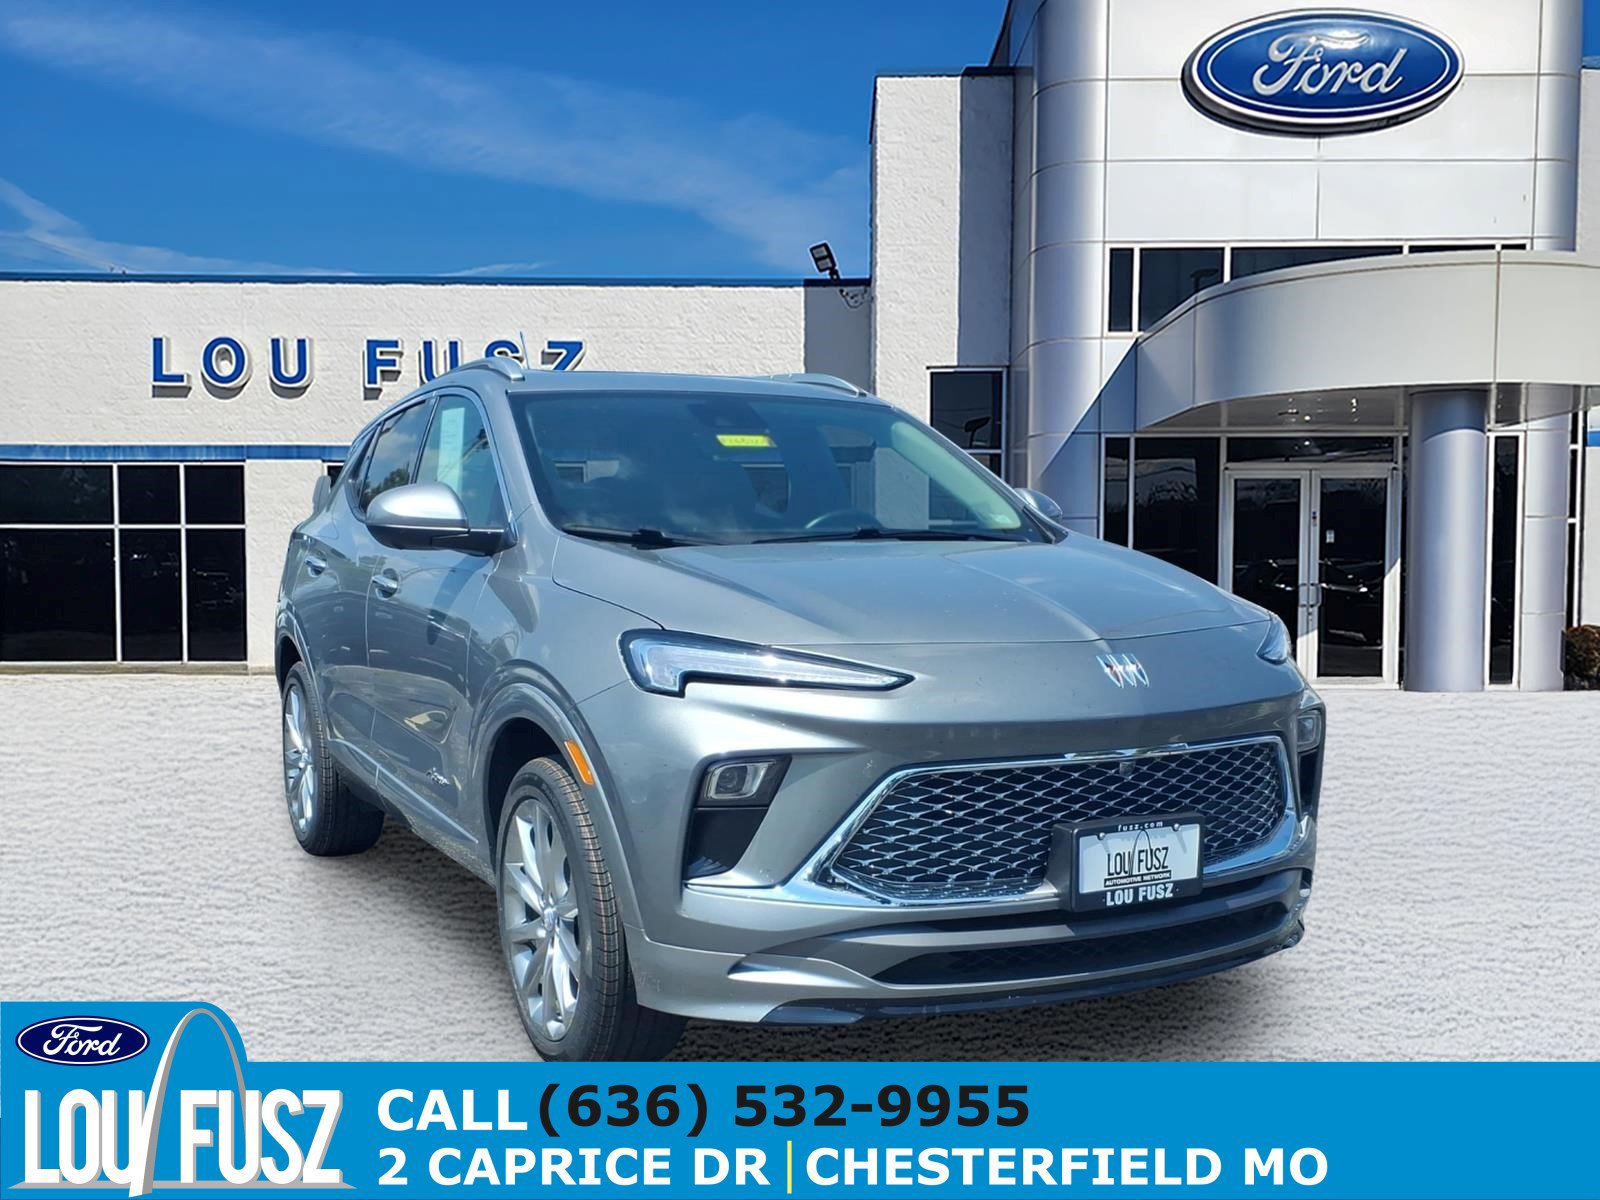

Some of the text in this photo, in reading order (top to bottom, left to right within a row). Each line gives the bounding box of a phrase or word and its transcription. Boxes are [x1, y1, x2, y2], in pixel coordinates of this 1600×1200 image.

[1252, 32, 1408, 96] Ford
[152, 336, 313, 388] LOU
[1107, 846, 1169, 876] LOU FUSZ
[1105, 872, 1171, 886] AUTOMOTIVE NETWORK
[1106, 883, 1174, 907] LOU FUSZ
